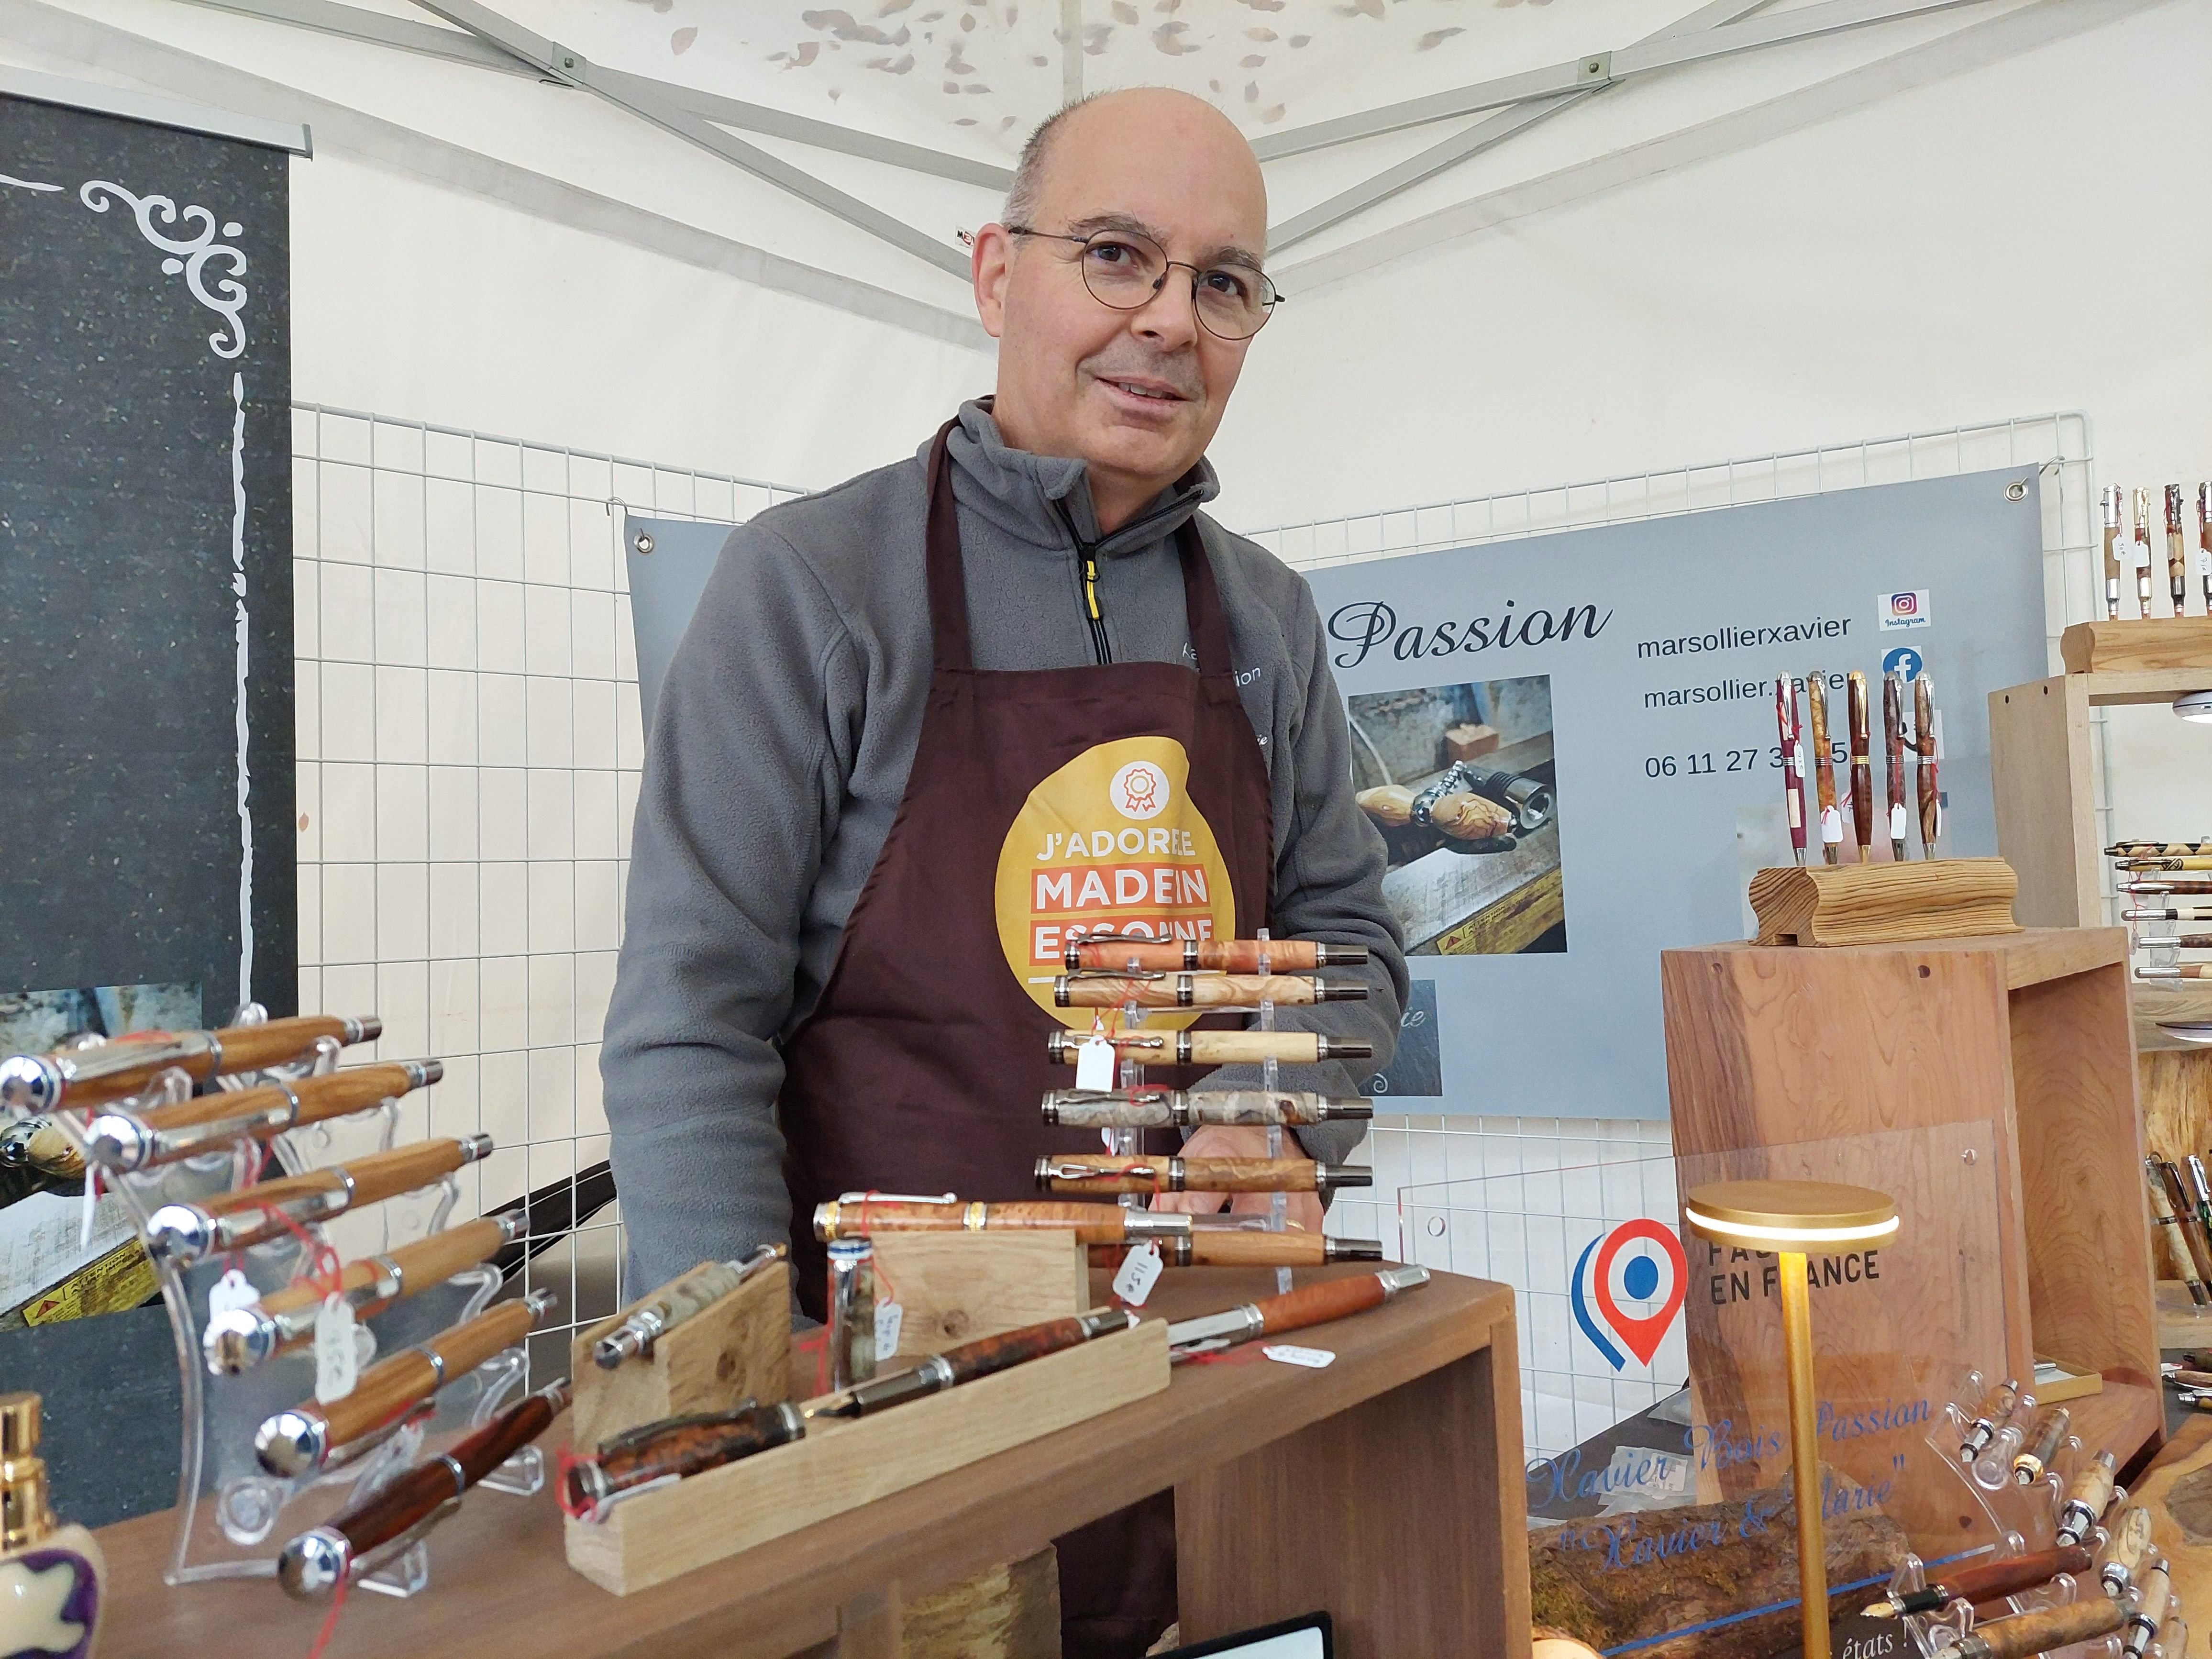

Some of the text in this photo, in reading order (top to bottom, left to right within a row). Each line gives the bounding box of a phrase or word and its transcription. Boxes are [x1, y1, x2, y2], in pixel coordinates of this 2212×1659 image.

[1327, 600, 1614, 669] Passion
[1637, 617, 1851, 658] marsollierxavier
[1885, 617, 1926, 628] Instagram
[1645, 756, 1677, 778] 06
[1687, 752, 1716, 774] 11
[1726, 749, 1758, 772] 27
[1036, 868, 1207, 909] MADE IN
[1711, 1250, 1880, 1305] EN FANCE
[1526, 1448, 1672, 1508] Xavier
[1683, 1419, 1782, 1471] Bois
[1816, 1398, 1934, 1442] Passion
[1842, 1633, 1893, 1659] états
